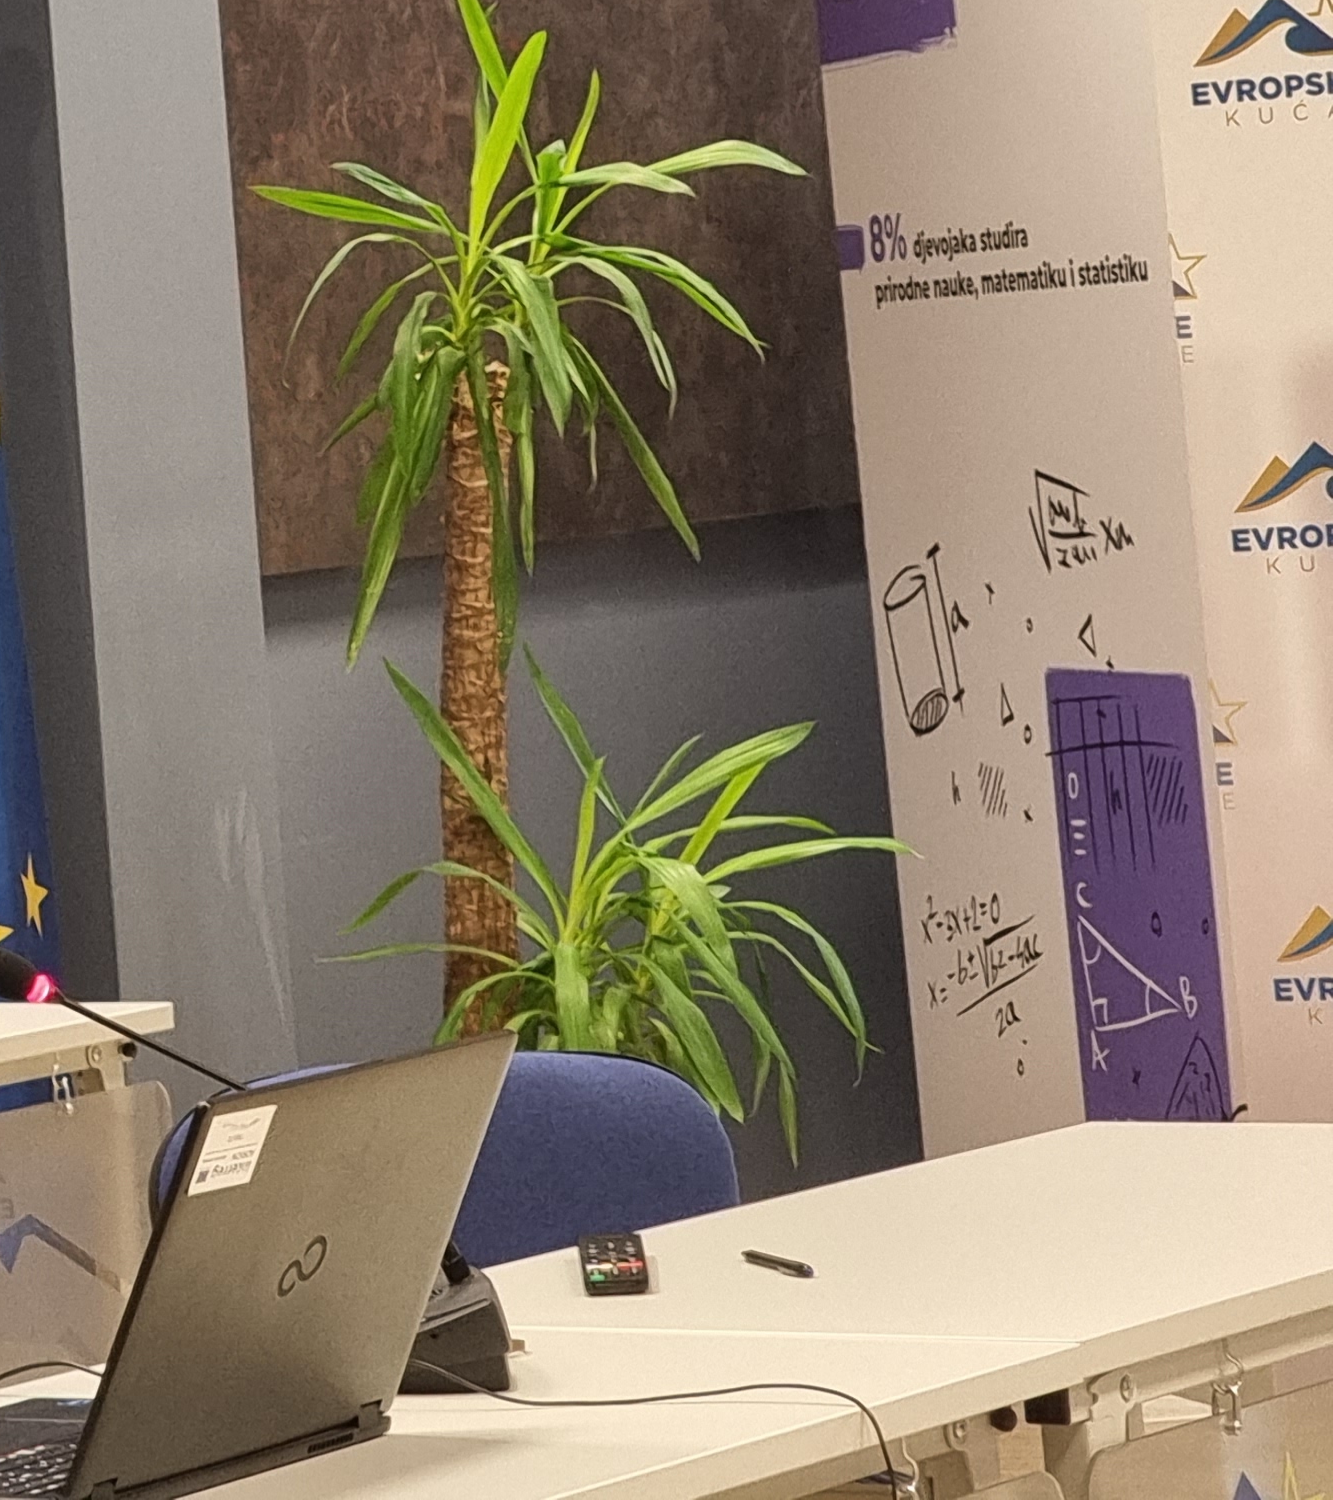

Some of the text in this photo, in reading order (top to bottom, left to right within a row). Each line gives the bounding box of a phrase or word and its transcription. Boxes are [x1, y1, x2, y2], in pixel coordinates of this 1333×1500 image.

[869, 212, 1029, 264] 8% djevojaka studira
[874, 253, 1149, 309] prirodne nauke, matematiku i statistiku
